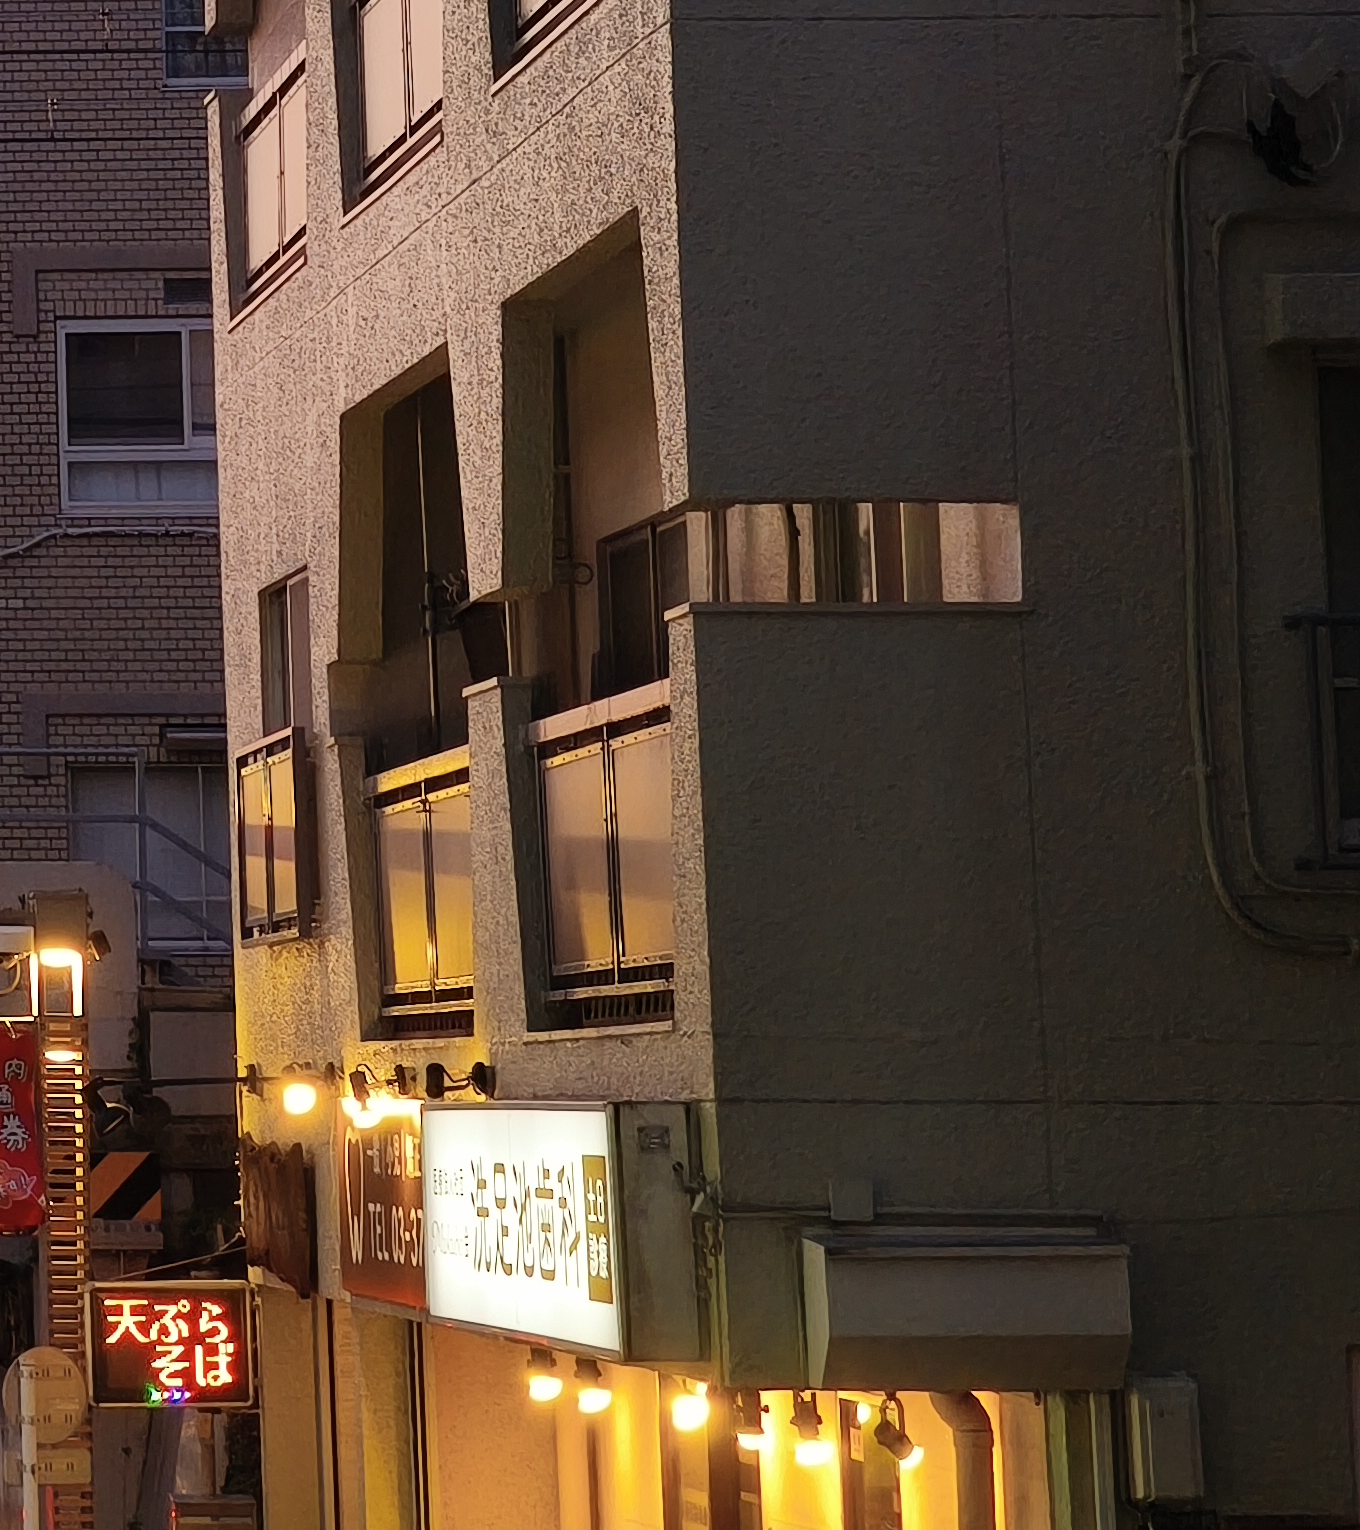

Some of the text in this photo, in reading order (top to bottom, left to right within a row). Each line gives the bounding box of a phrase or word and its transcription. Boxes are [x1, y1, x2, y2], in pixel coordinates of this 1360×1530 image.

[367, 1202, 390, 1262] TEL
[470, 1156, 581, 1288] 洗足池歯科
[103, 1299, 229, 1344] 天ぷら
[150, 1342, 235, 1387] そば
